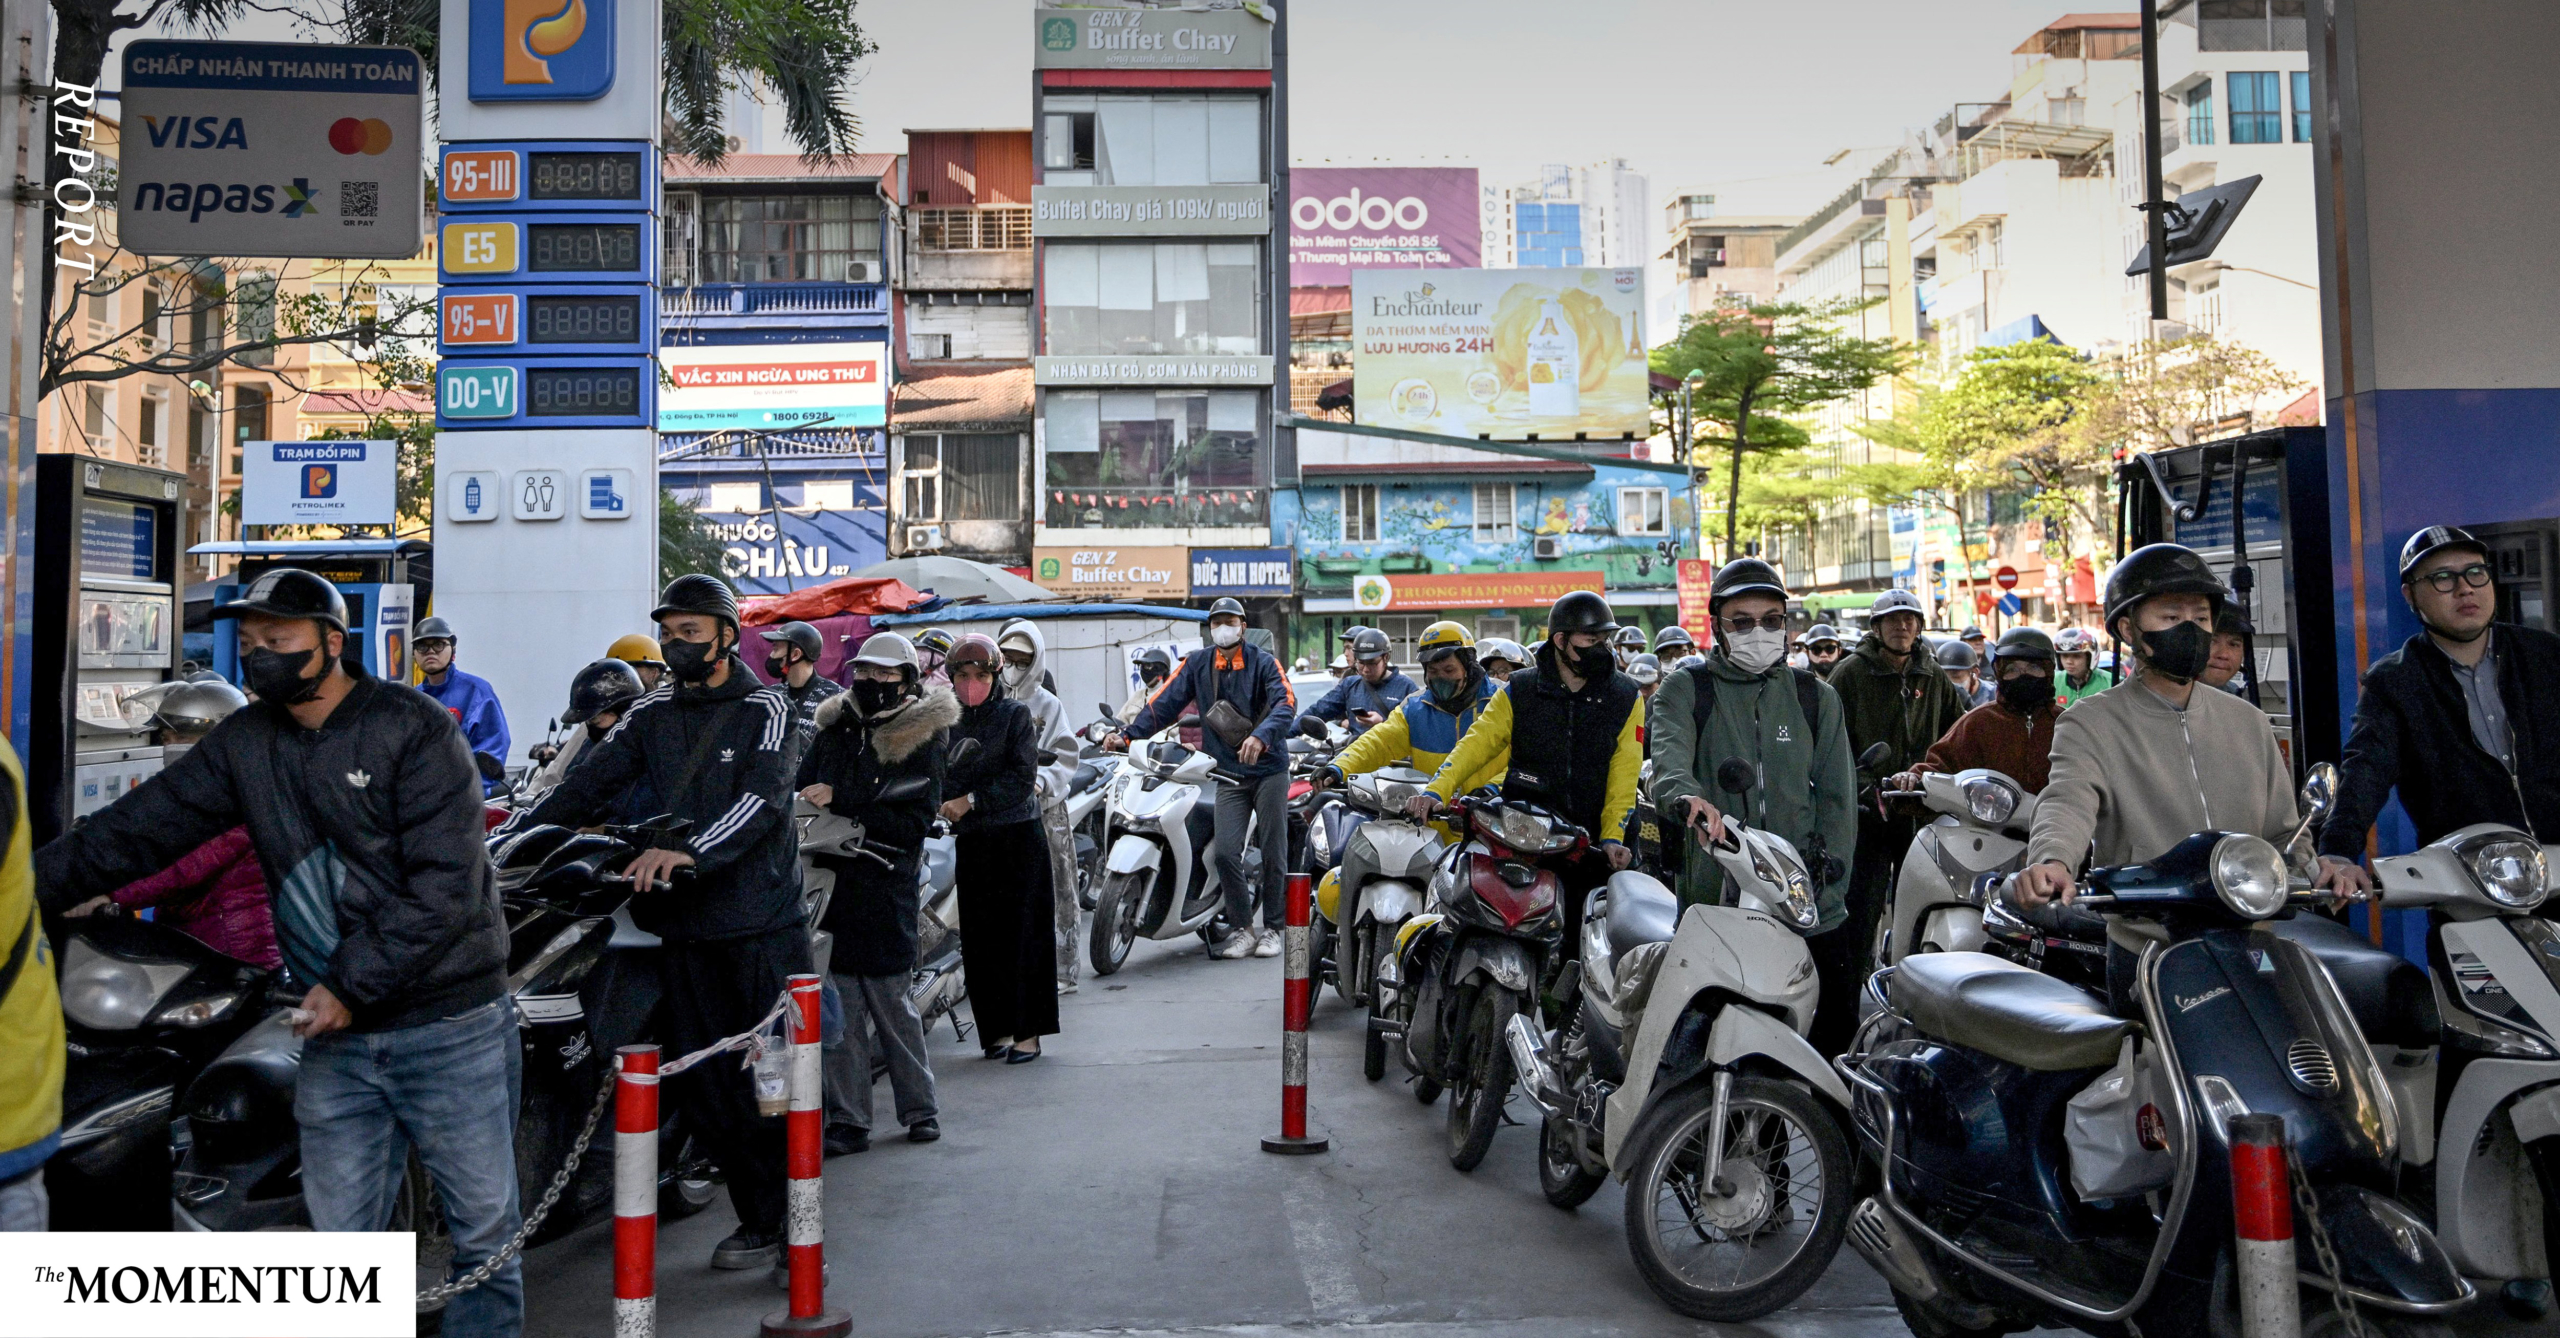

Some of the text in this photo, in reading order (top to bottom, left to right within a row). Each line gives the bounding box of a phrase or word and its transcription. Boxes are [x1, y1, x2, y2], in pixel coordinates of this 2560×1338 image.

[1088, 11, 1143, 27] GEN Z
[1088, 28, 1237, 55] Buffet Chay
[133, 53, 413, 81] CHẤP NHẬN THANH TOÁN
[1106, 52, 1129, 65] sống
[1131, 54, 1159, 65] xanh,
[1176, 53, 1200, 64] lành
[138, 115, 248, 150] VISA
[451, 160, 511, 192] 95-III
[134, 182, 275, 223] napas
[1038, 198, 1264, 221] Buffet Chay giá 109k/ người
[1291, 187, 1428, 231] odoo
[464, 232, 496, 264] E5
[1316, 234, 1347, 247] Mềm
[1349, 234, 1397, 249] Chuyển
[1398, 234, 1420, 247] Đổi
[1421, 234, 1439, 247] Số
[1349, 251, 1373, 265] Mại
[1374, 252, 1391, 263] Ra
[1394, 250, 1423, 263] Toàn
[1426, 250, 1451, 263] Cầu
[1373, 291, 1483, 317] Enchanteur
[1366, 322, 1490, 337] DA THƠM MỀM MỊN
[1364, 337, 1495, 354] LƯU HƯƠNG 24H
[679, 366, 866, 384] VẮC XIN NGỪA UNG THƯ
[1051, 362, 1090, 380] NHẬN
[1092, 362, 1119, 380] ĐẶT
[1148, 363, 1180, 378] CƠM
[1182, 361, 1209, 378] VĂN
[1212, 361, 1258, 378] PHÒNG
[448, 376, 508, 408] DO-V
[773, 412, 799, 421] 1800
[802, 411, 829, 421] 6928
[279, 444, 360, 460] TRẠM ĐỔI PIN
[704, 516, 776, 542] THUỐC
[720, 539, 828, 578] CHÂU
[1071, 551, 1118, 565] GEN Z
[829, 565, 850, 576] 427
[1071, 566, 1172, 585] Buffet Chay
[1193, 556, 1291, 586] ĐỨC ANH HOTEL
[1501, 584, 1535, 597] NON
[83, 784, 98, 797] VISA
[1505, 863, 1530, 872] HONDA
[1746, 916, 1777, 930] HONDA
[2069, 942, 2100, 953] HONDA
[2175, 987, 2232, 1009] Vespa
[564, 1046, 591, 1070] adidas
